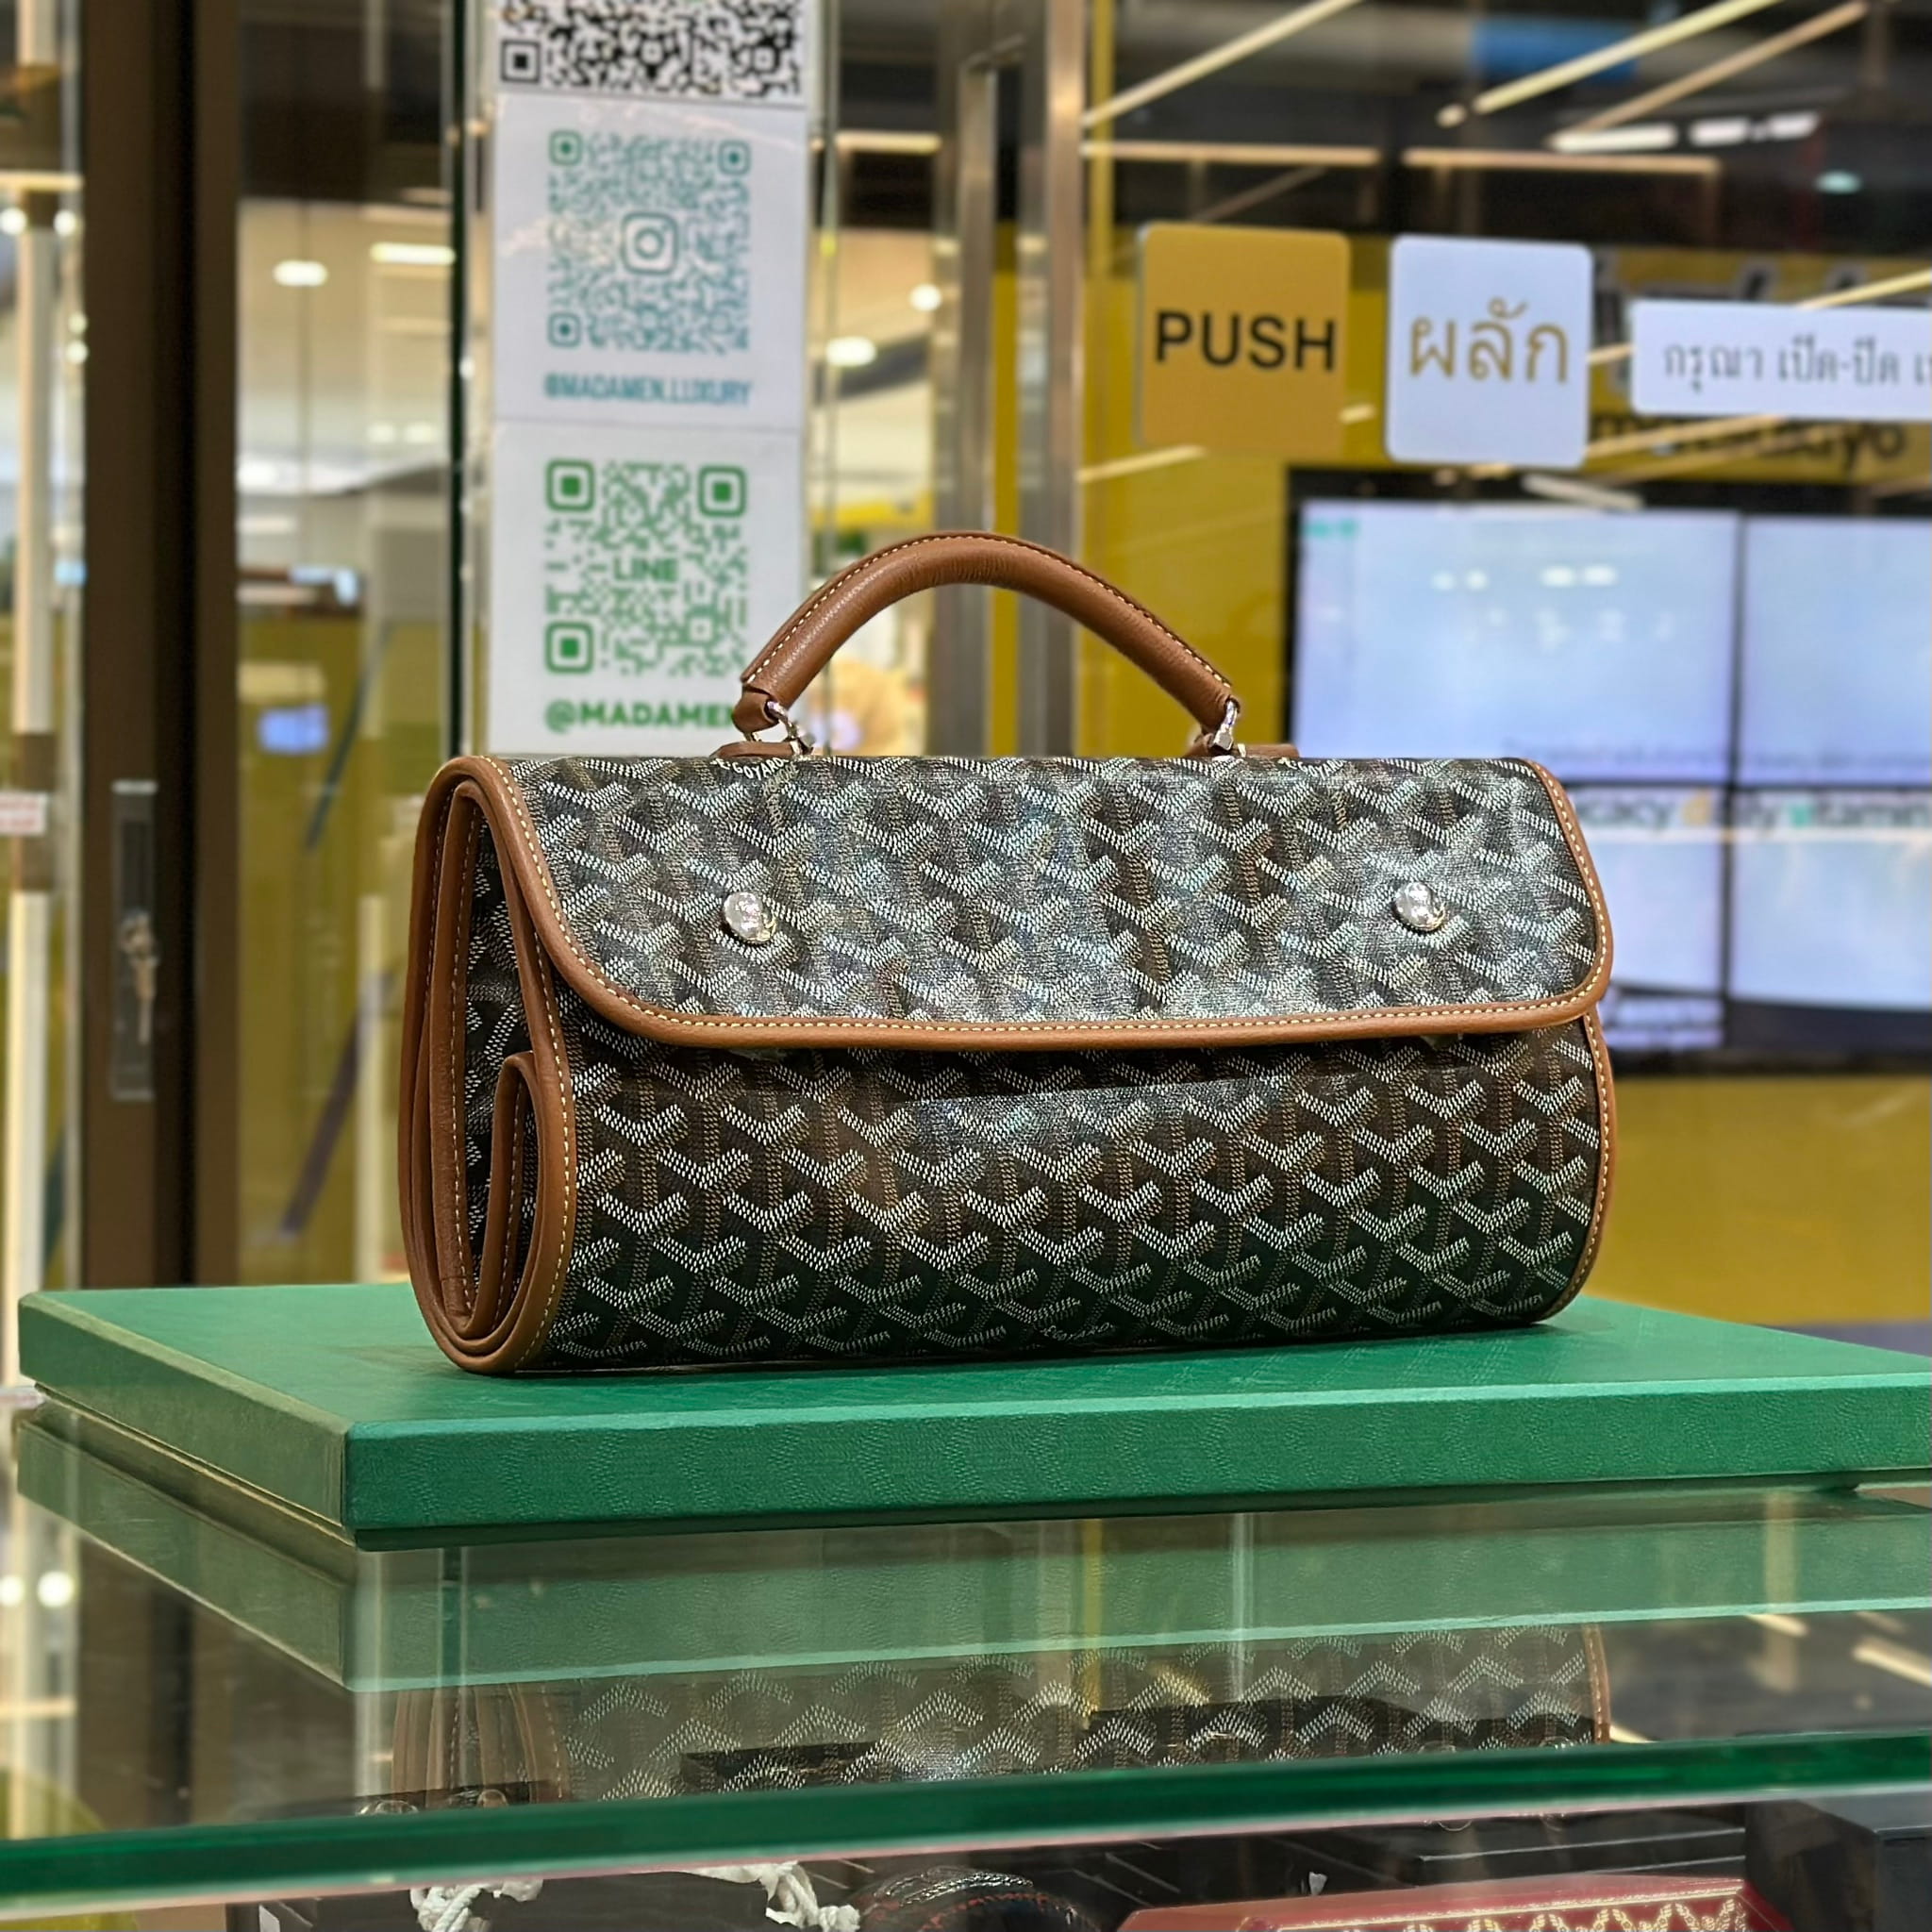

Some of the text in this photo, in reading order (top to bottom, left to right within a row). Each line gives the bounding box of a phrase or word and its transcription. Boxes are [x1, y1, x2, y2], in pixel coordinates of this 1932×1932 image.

[1154, 310, 1337, 372] PUSH
[1408, 296, 1569, 384] ผลัก
[1664, 343, 1765, 395] กรุณา
[612, 558, 680, 583] LINE
